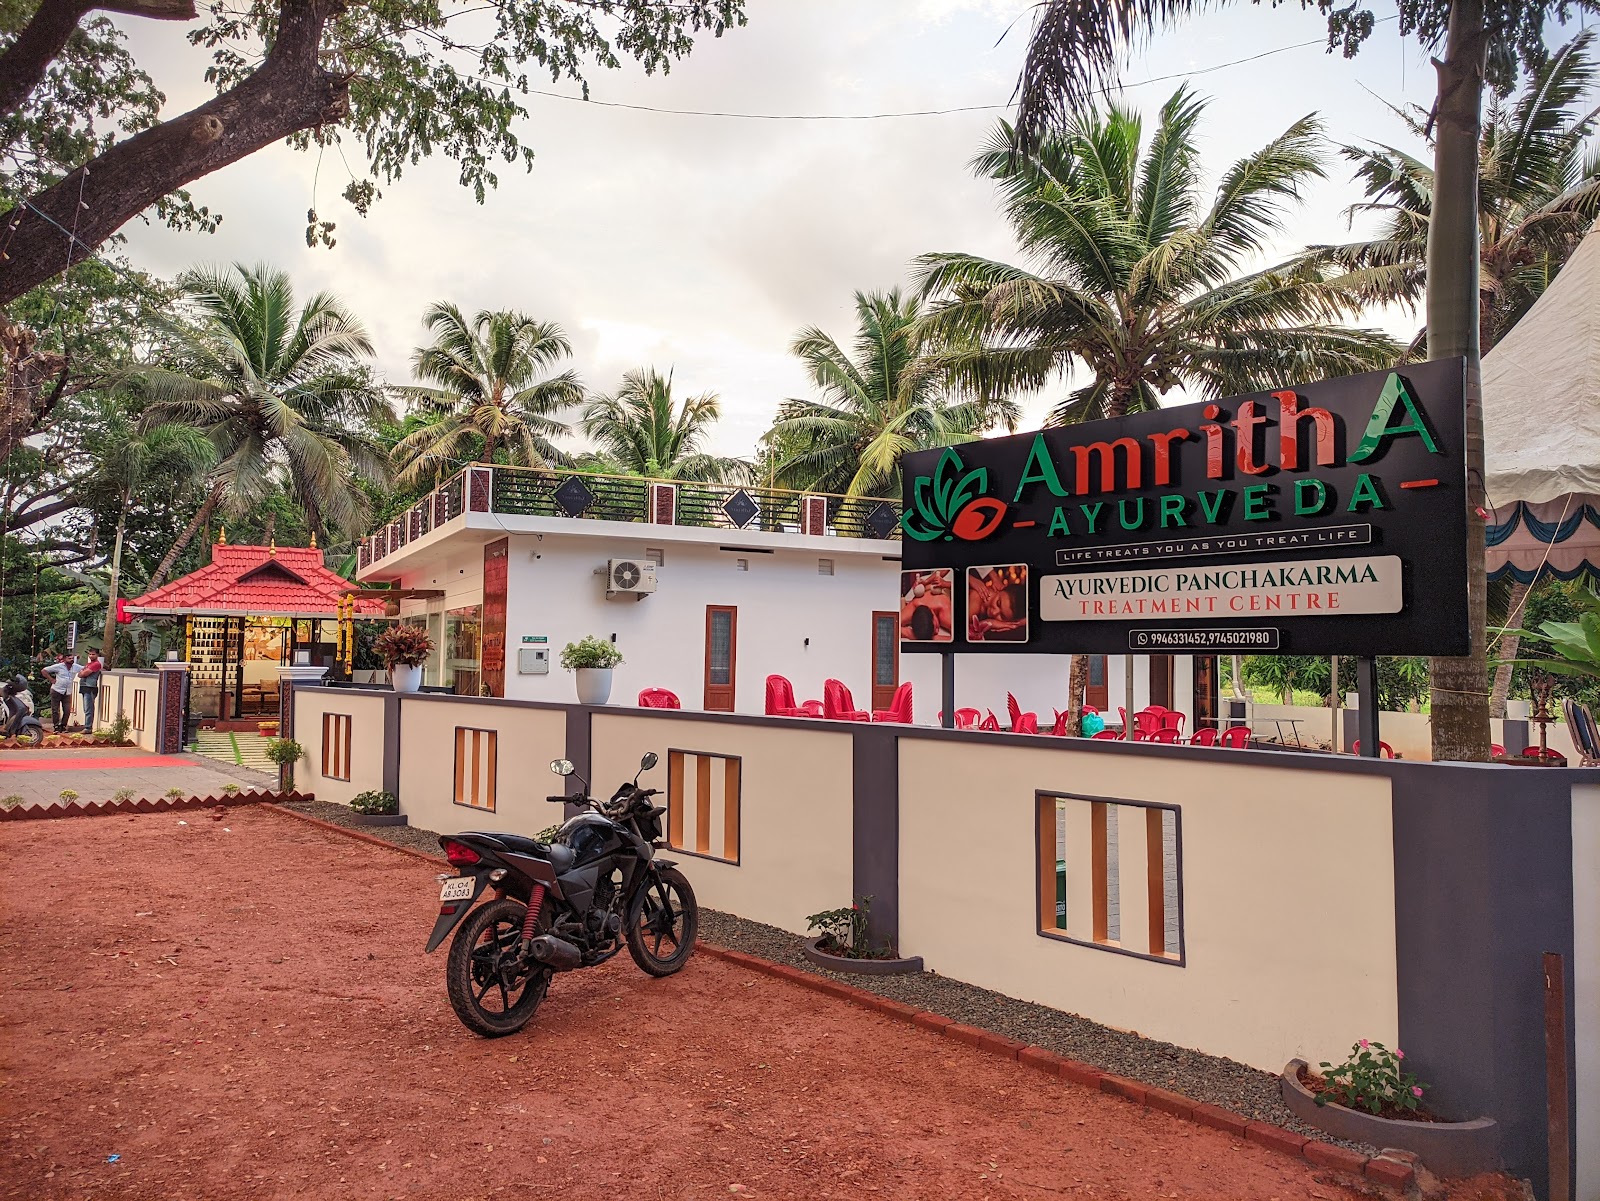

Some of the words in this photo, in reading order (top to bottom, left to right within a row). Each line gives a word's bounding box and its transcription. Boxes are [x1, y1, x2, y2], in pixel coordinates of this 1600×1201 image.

[1047, 473, 1385, 537] AYURVEDA
[1064, 551, 1092, 561] LIFE
[1097, 548, 1149, 558] TREATS
[1156, 545, 1184, 554] YOU
[1217, 539, 1248, 548] YOU
[1256, 535, 1309, 546] TREAT
[1318, 530, 1358, 541] LIFE
[1054, 574, 1169, 600] AYURVEDIC
[1176, 563, 1380, 592] PANCHAKARMA
[1079, 596, 1218, 615] TREATMENT
[1229, 592, 1341, 611] CENTRE
[1151, 631, 1270, 645] 9946331452,9745021980
